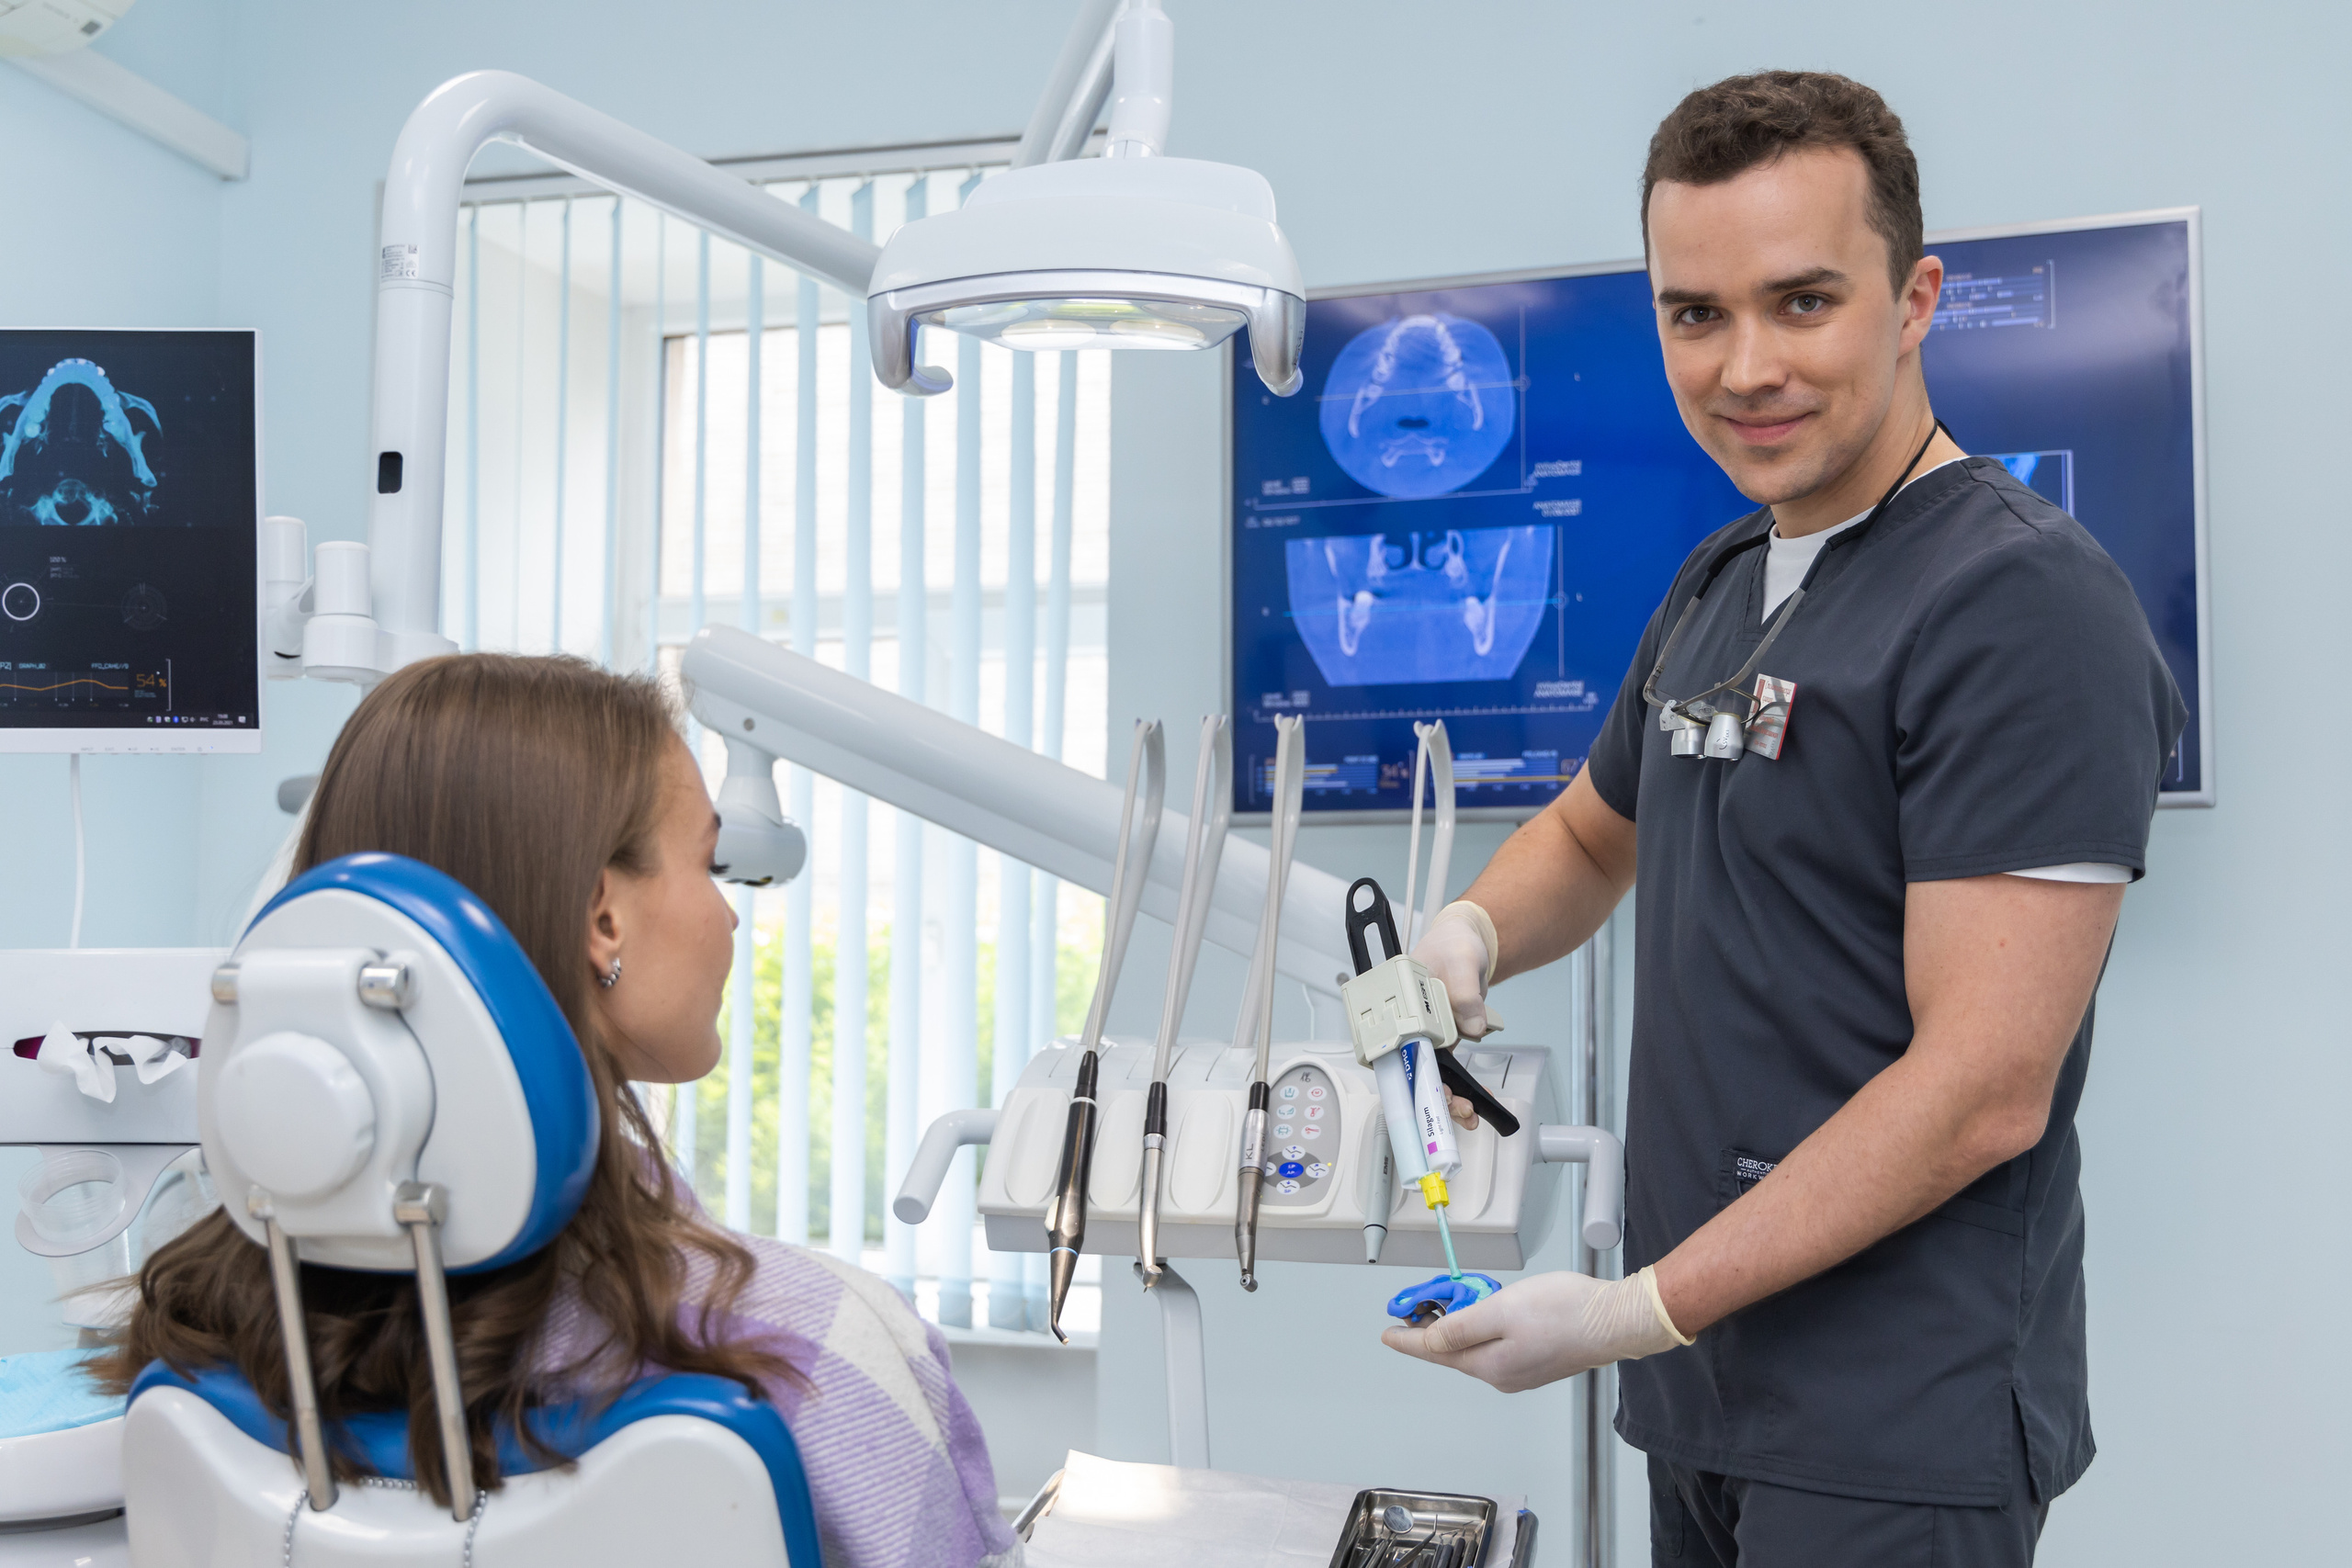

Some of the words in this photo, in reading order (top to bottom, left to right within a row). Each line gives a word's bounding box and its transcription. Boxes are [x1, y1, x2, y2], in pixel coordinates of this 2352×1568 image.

[136, 673, 154, 687] 54
[1401, 1049, 1411, 1072] DMG
[1423, 1106, 1435, 1137] Silagum
[1245, 1143, 1254, 1160] KL
